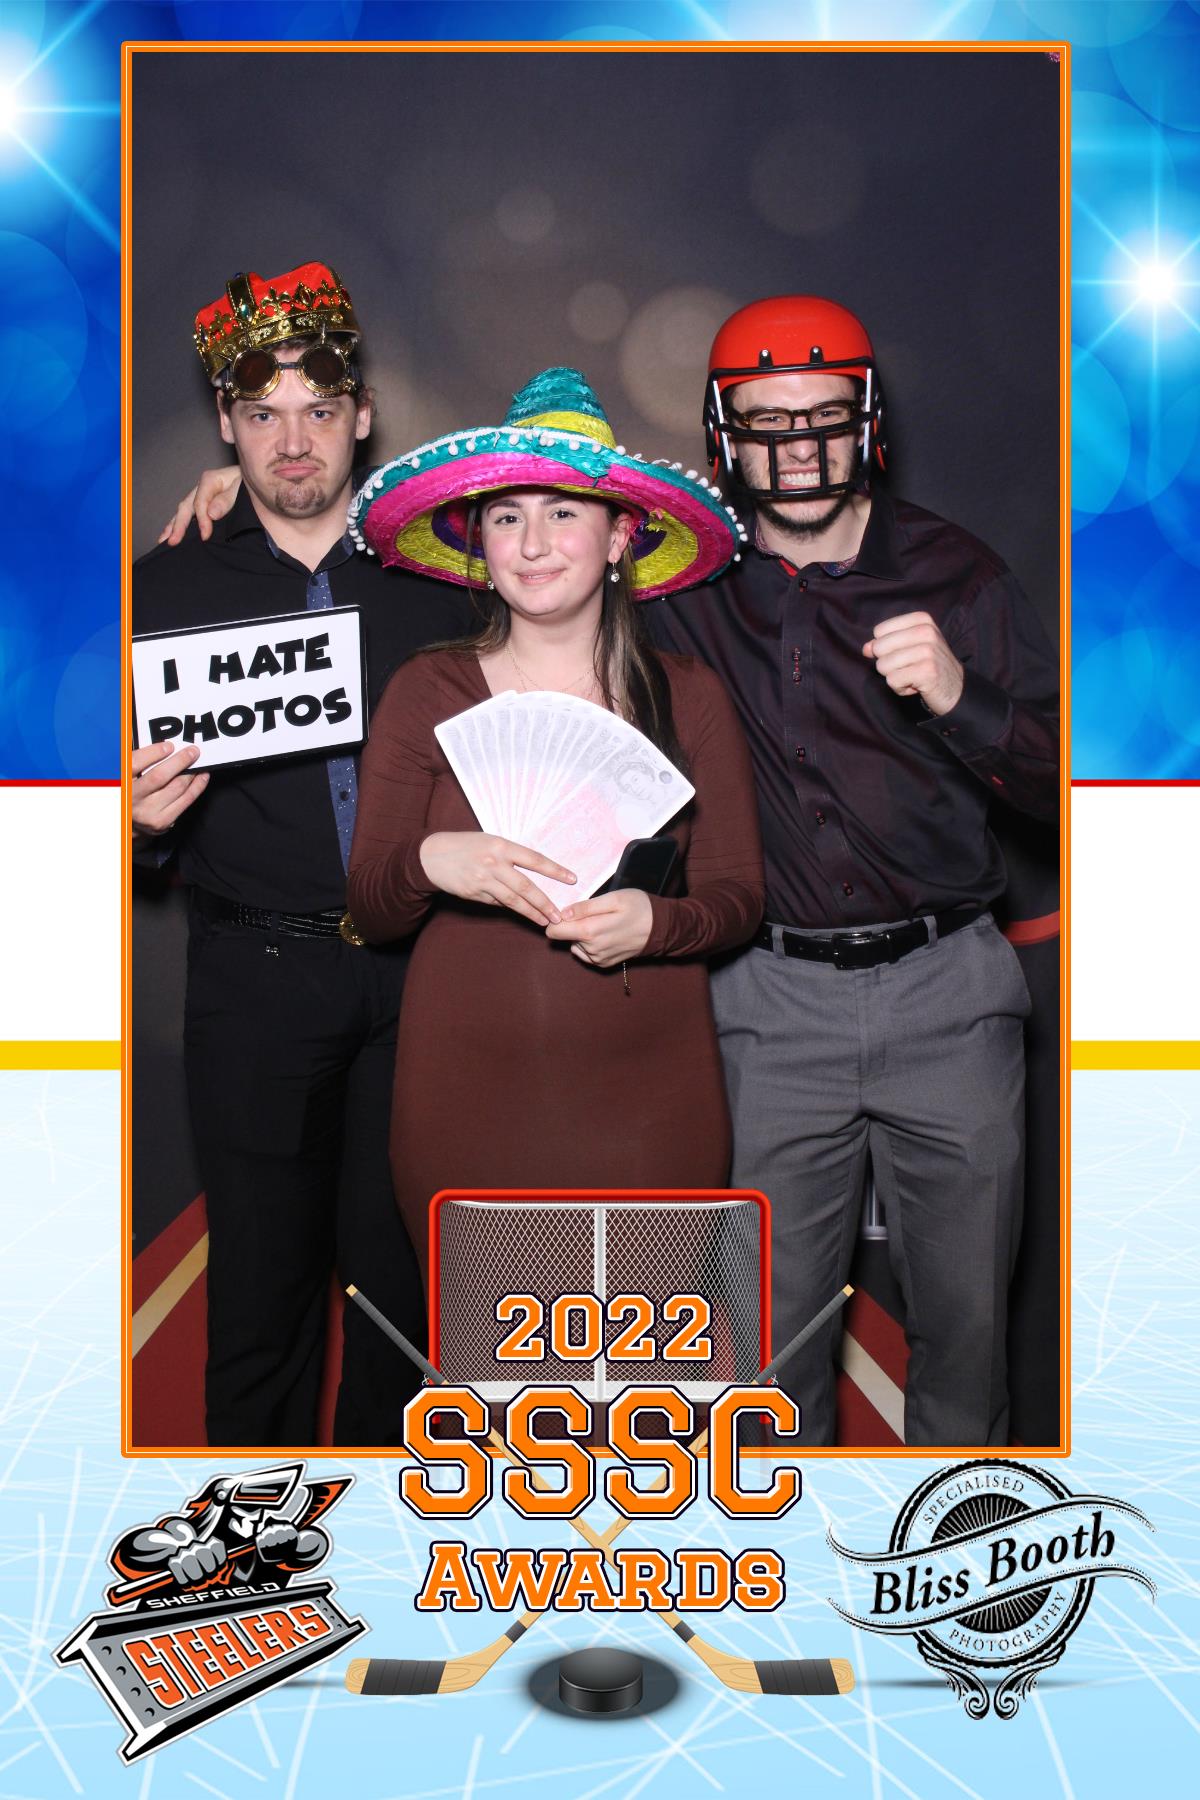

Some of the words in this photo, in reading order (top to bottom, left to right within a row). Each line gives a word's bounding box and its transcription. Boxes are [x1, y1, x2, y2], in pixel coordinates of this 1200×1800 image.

[163, 659, 180, 694] I
[208, 632, 333, 684] HATE
[148, 687, 353, 744] PHOTOS
